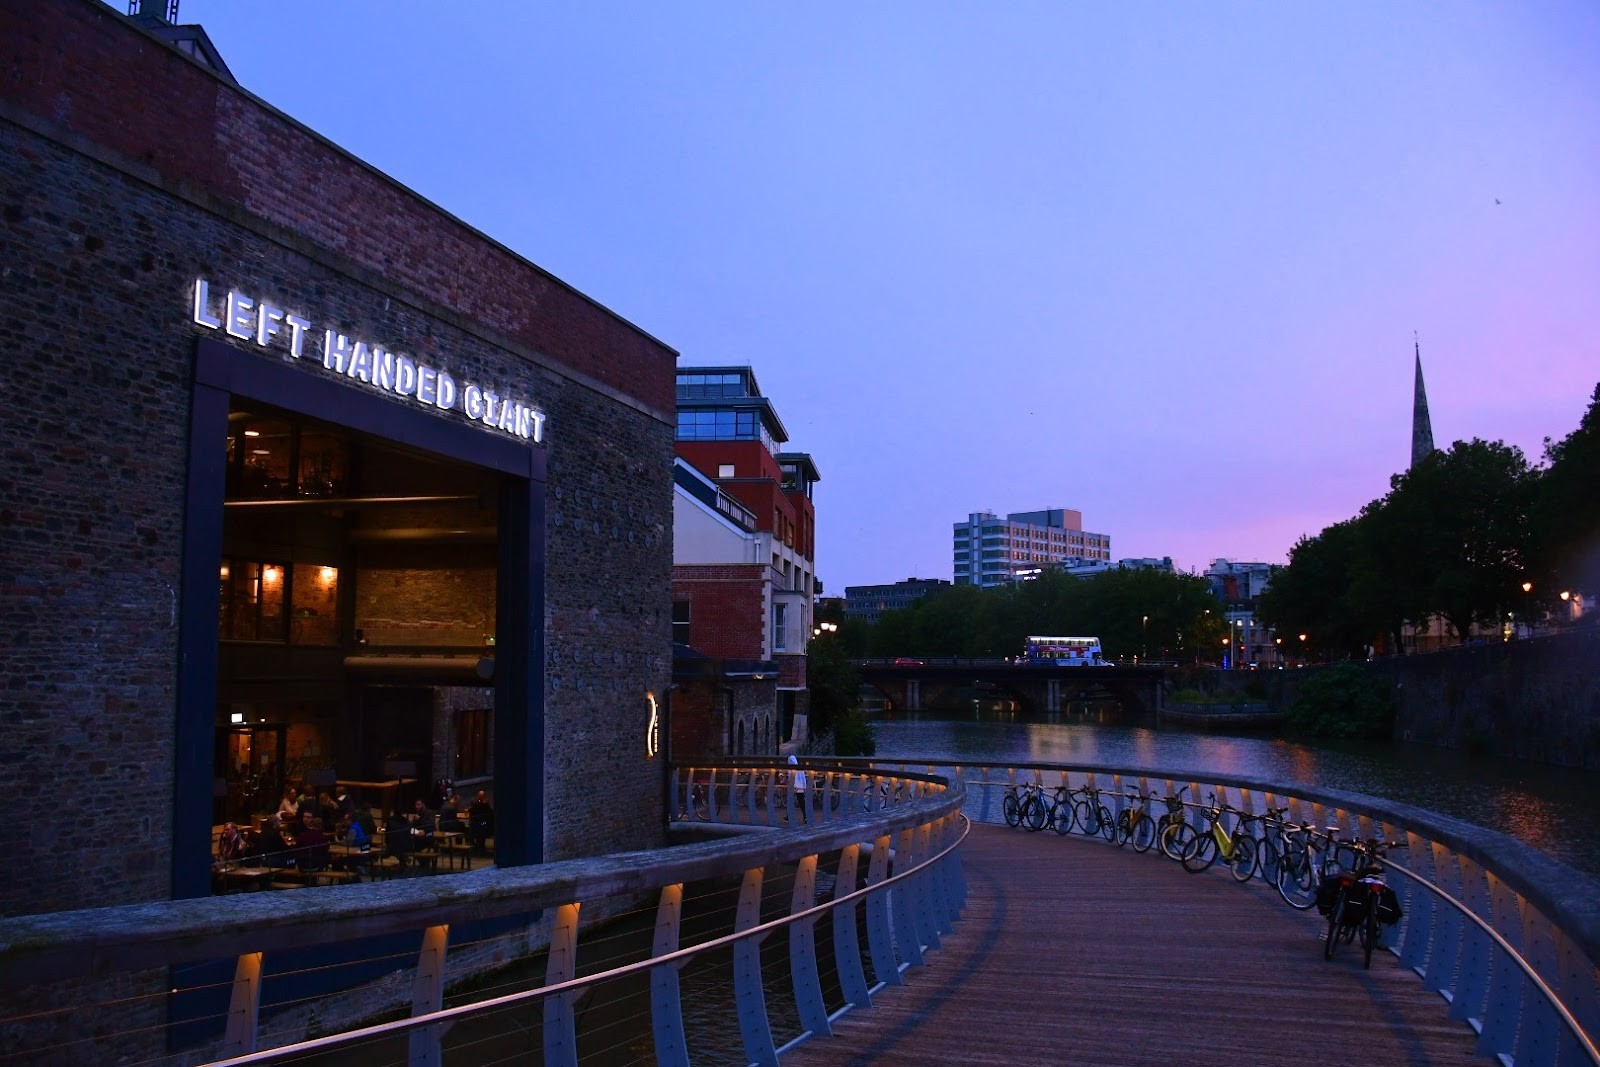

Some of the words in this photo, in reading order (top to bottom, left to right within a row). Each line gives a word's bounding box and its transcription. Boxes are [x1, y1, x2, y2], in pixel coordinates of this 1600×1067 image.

[194, 277, 310, 358] LEFT
[324, 329, 457, 410] HANDED
[464, 384, 546, 443] GIANT
